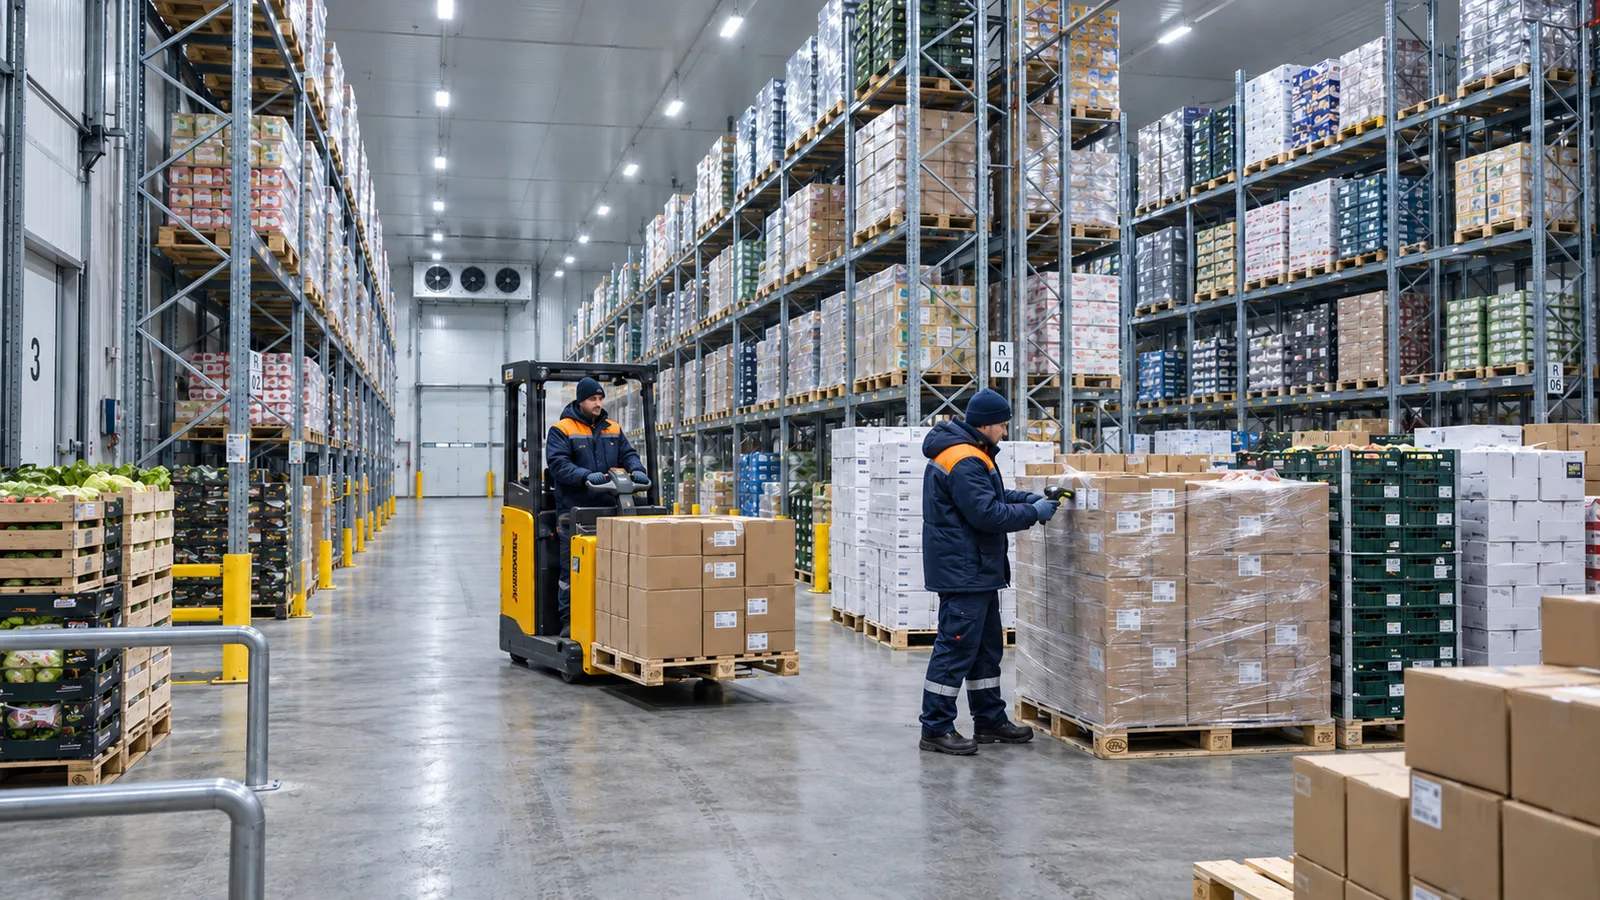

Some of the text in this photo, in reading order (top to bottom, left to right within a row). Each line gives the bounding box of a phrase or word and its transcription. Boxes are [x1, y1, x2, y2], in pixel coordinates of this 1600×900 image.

[998, 344, 1006, 356] R
[30, 337, 40, 382] 3
[253, 354, 259, 369] R
[994, 361, 1010, 374] 04
[1553, 364, 1559, 376] R
[251, 374, 261, 391] 02
[1550, 379, 1561, 391] 06
